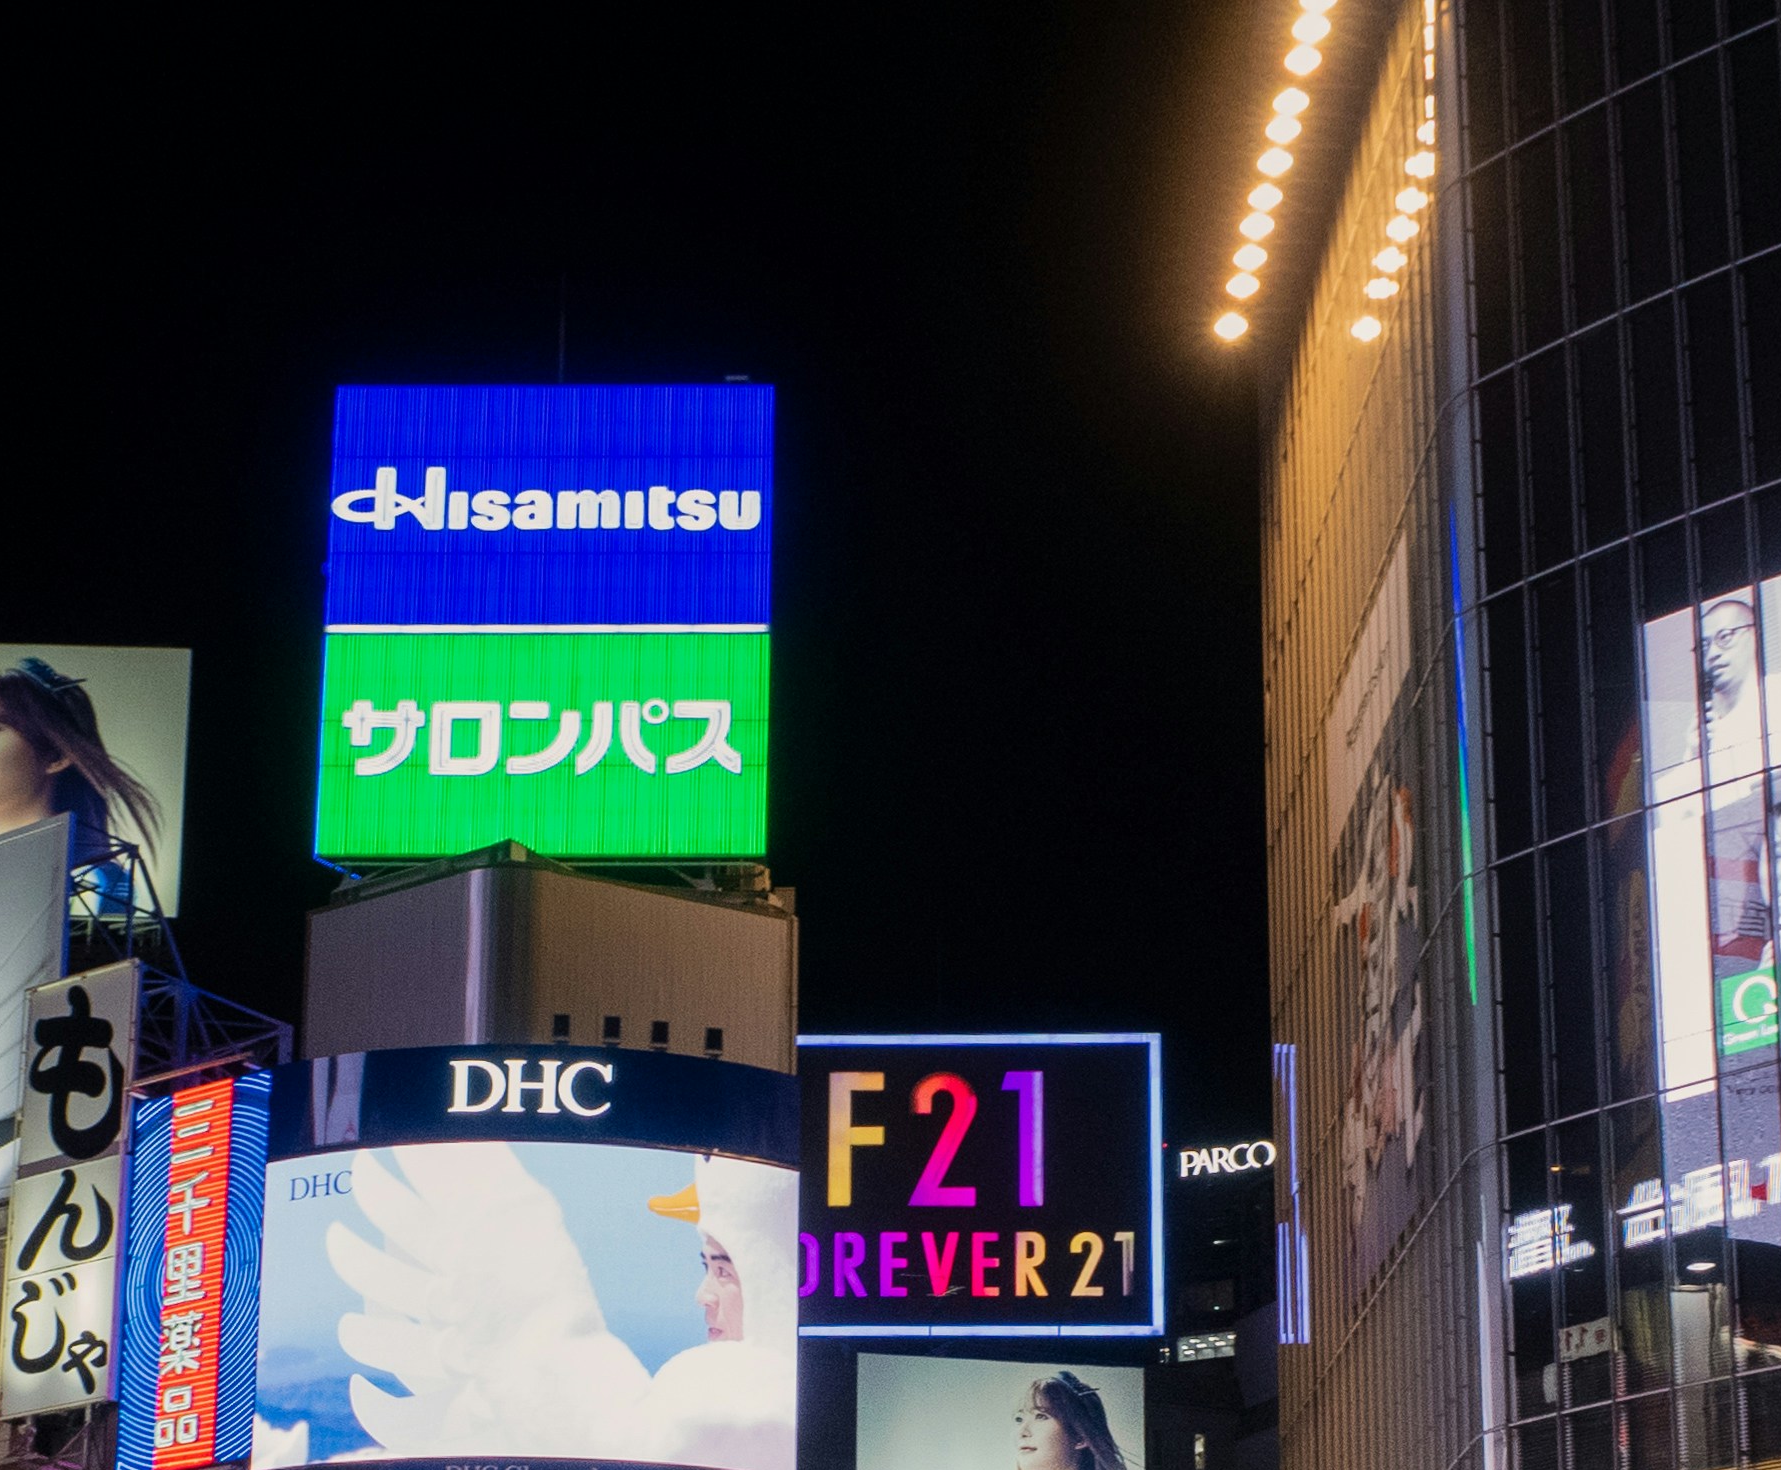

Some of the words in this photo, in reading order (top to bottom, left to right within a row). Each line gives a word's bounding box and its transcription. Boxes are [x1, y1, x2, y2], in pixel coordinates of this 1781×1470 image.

[332, 466, 761, 531] Hisamitsu
[342, 698, 742, 776] サロンパス
[447, 1060, 614, 1117] DHC
[827, 1070, 1044, 1207] F21
[1179, 1141, 1277, 1178] PARCO
[11, 984, 124, 1396] もんじゃ
[288, 1170, 353, 1202] DHC
[154, 1097, 216, 1448] 三千里薬品
[798, 1231, 1048, 1298] OREVER
[1069, 1231, 1135, 1298] 21
